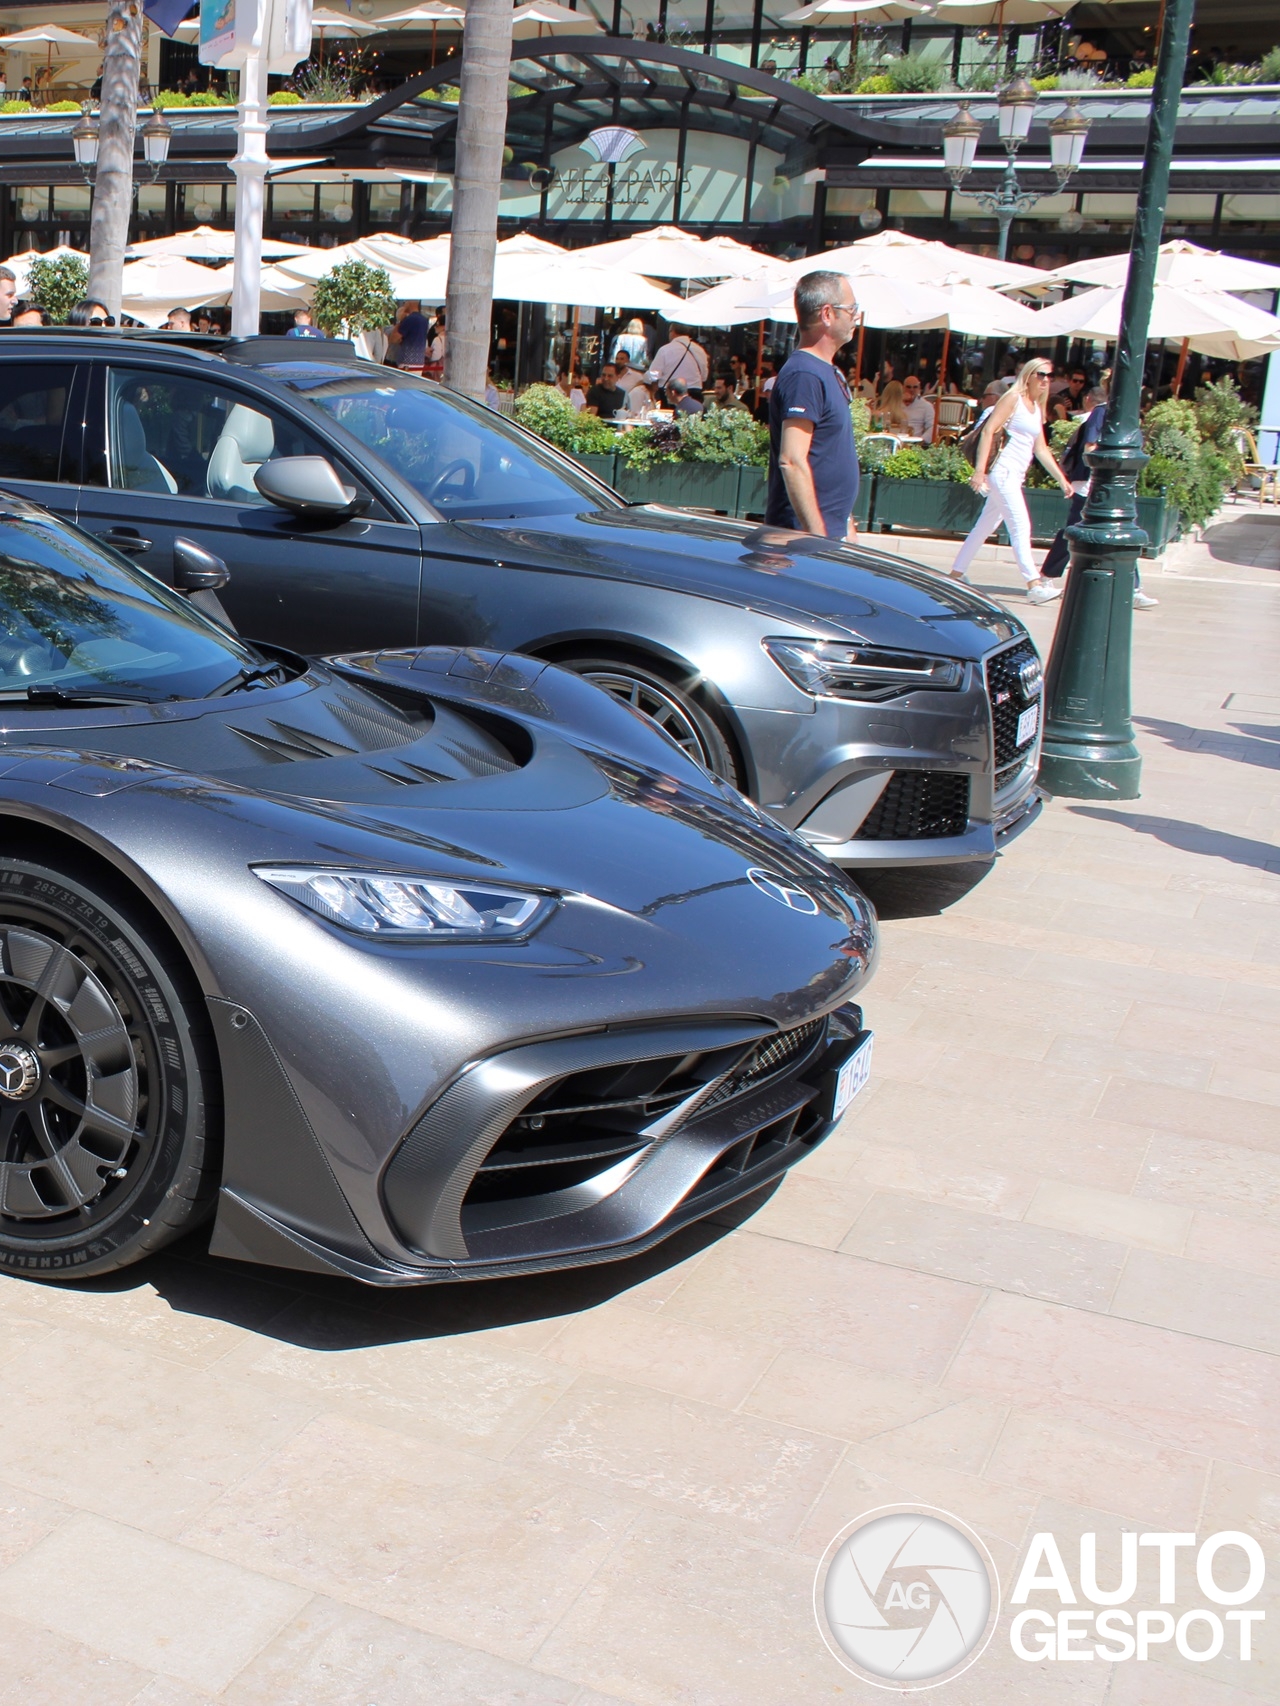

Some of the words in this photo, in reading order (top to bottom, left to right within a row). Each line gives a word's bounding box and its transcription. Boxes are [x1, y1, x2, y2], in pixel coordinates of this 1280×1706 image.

[600, 172, 619, 189] DE
[627, 168, 693, 194] PARIS
[33, 880, 77, 905] 285/35
[76, 902, 95, 918] ZR
[94, 915, 109, 929] 19
